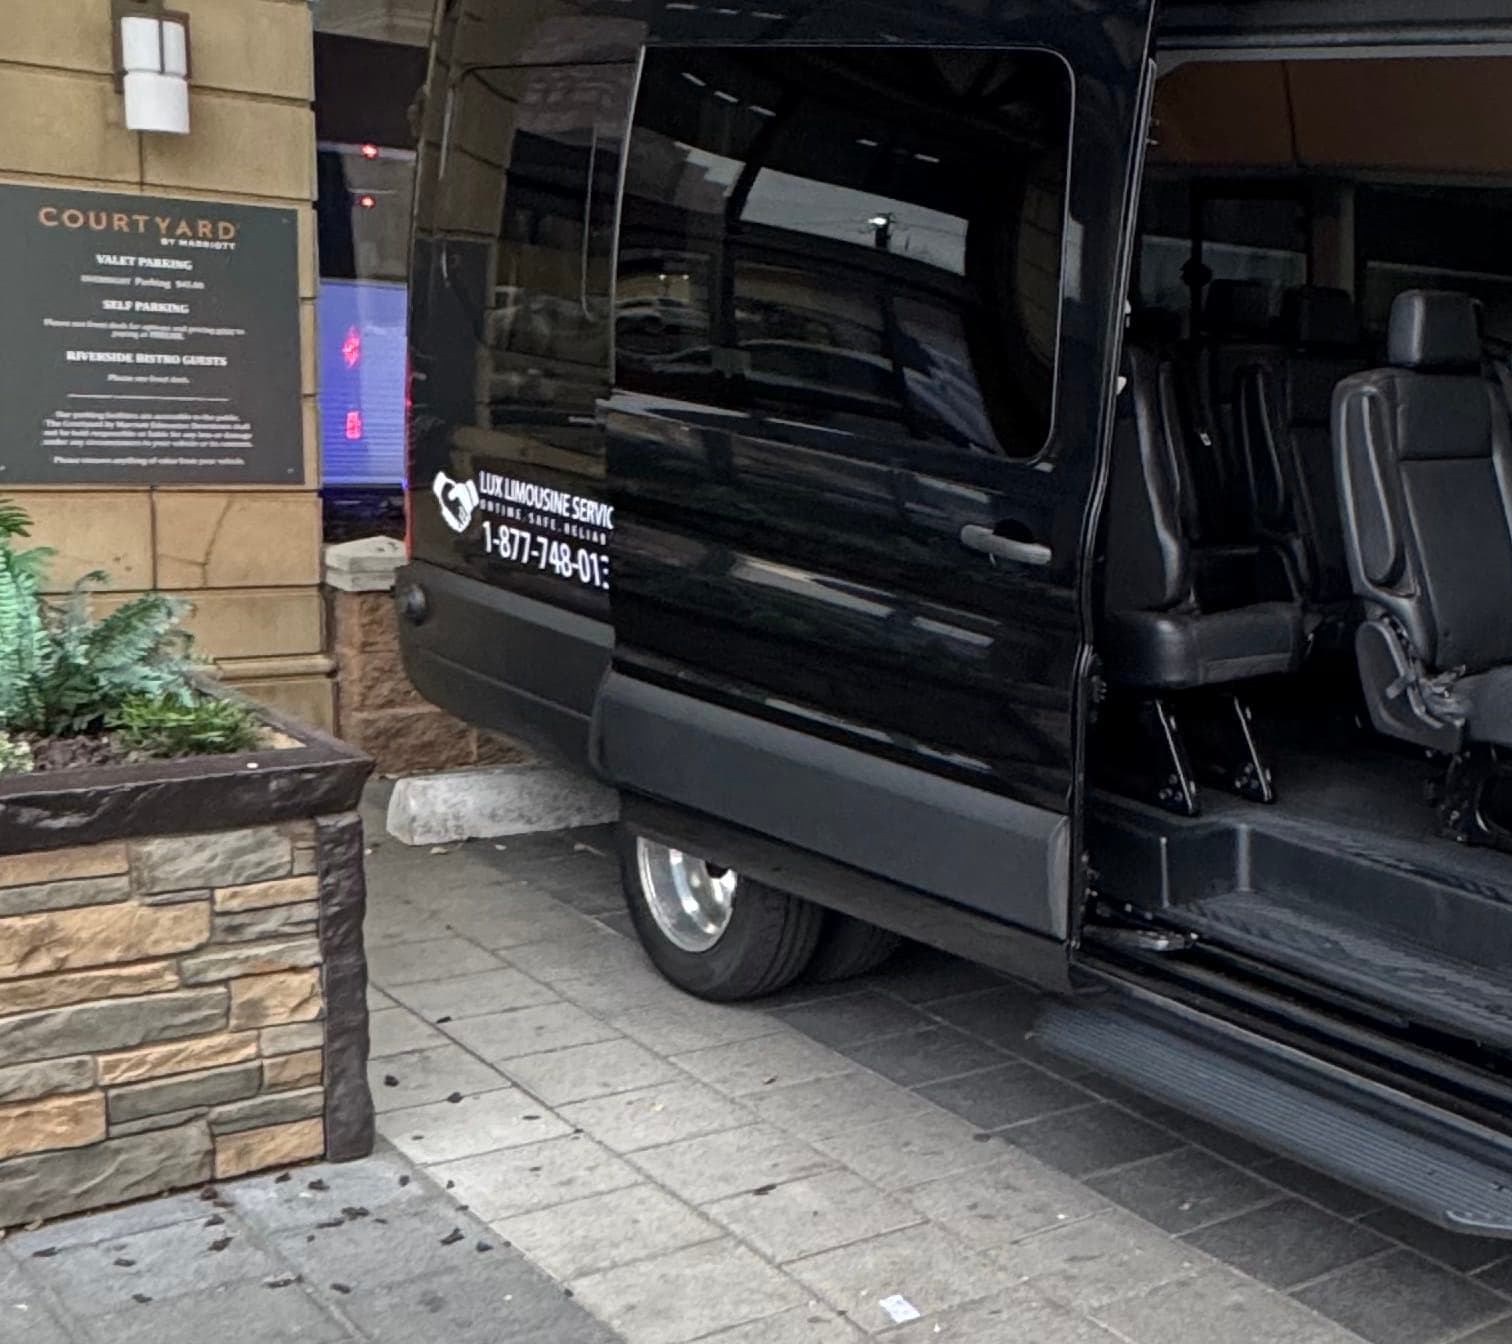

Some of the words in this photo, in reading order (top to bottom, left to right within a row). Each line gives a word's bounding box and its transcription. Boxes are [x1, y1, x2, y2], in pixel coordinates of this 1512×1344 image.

[38, 207, 236, 240] COURTYARD
[160, 238, 176, 246] BY
[178, 239, 236, 250] MARRIOTT
[96, 254, 136, 266] VALET
[138, 257, 193, 270] PARKING
[102, 299, 133, 311] SELF
[135, 301, 189, 314] PARKING
[479, 470, 503, 498] LUX
[504, 477, 571, 517] LIMOUSINE
